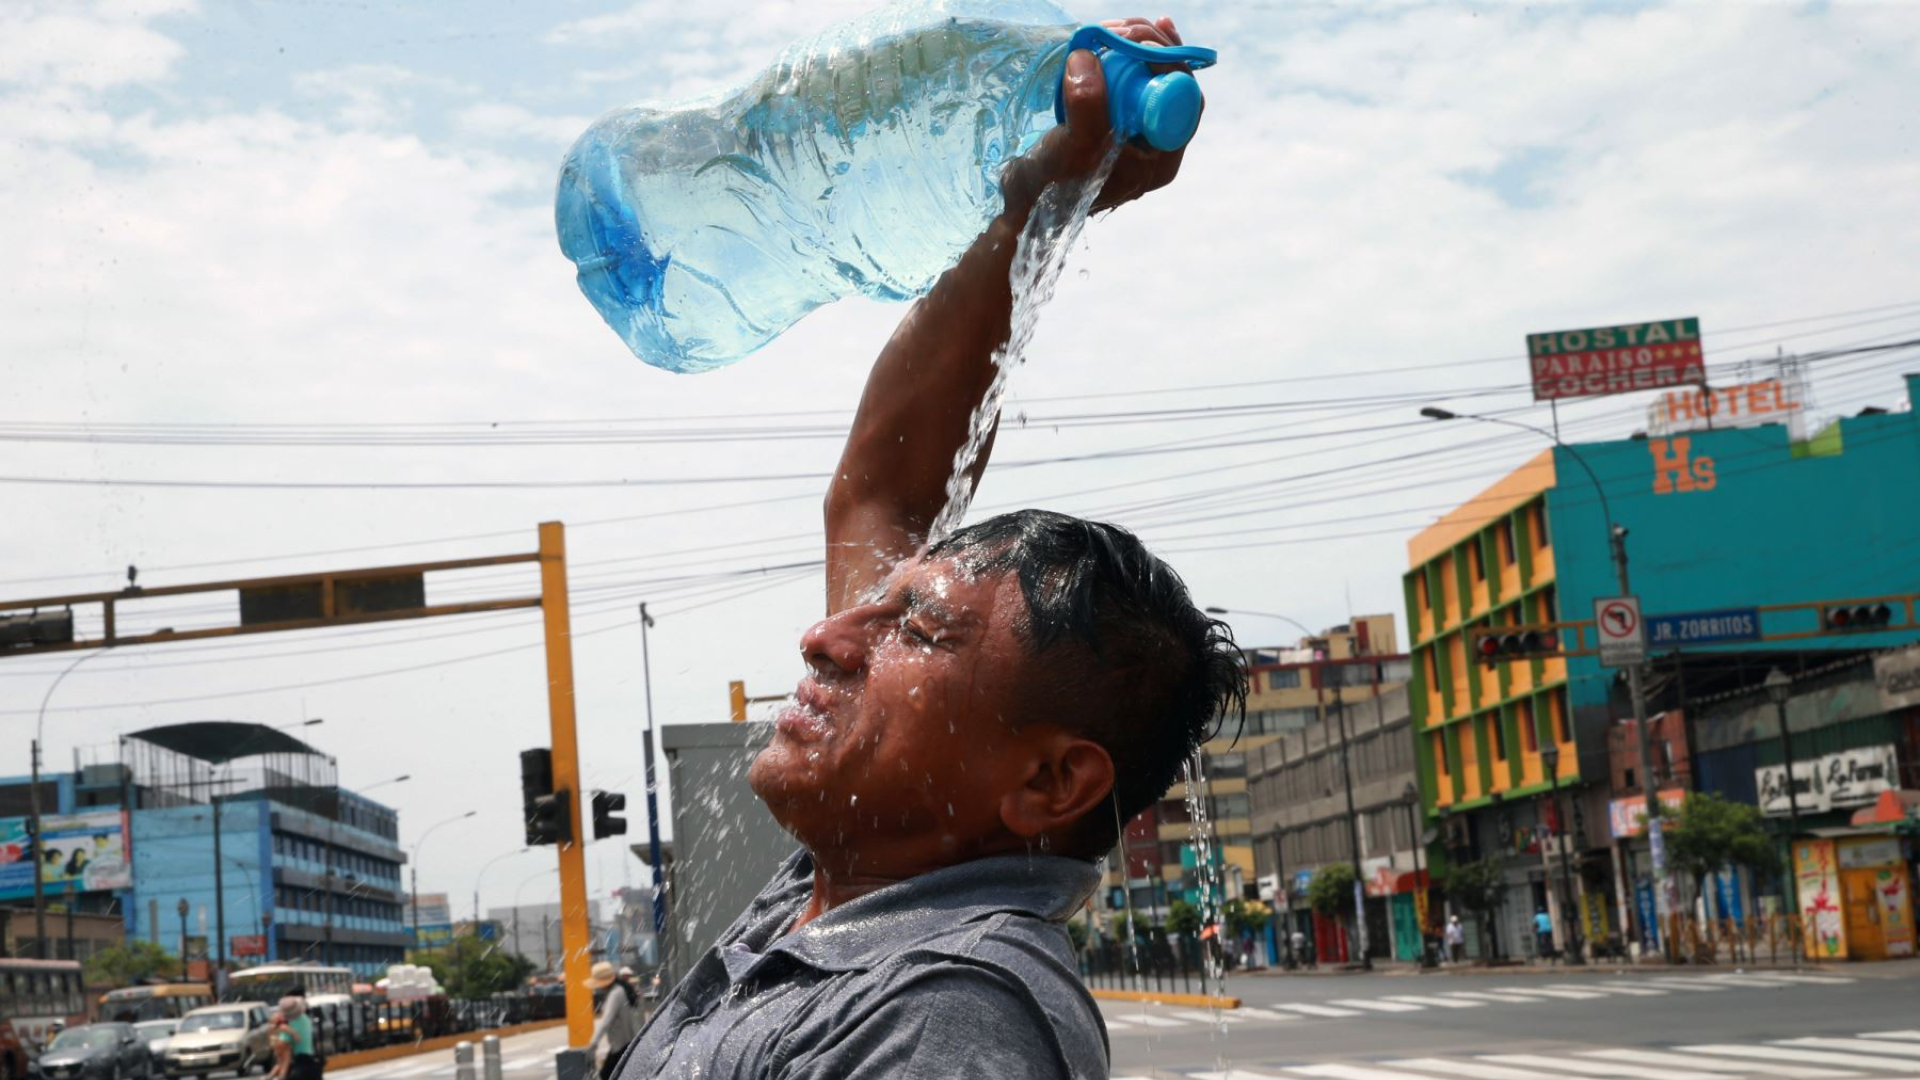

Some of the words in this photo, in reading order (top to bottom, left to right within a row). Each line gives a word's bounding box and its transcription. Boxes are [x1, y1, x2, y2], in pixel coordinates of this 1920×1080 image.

[1532, 319, 1697, 354] HOSTAL
[1535, 347, 1654, 376] PARAISO
[1535, 362, 1703, 397] COCHERA
[1665, 378, 1801, 422] HOTEL
[1653, 621, 1677, 641] JR.
[1679, 615, 1753, 639] ZORRITOS
